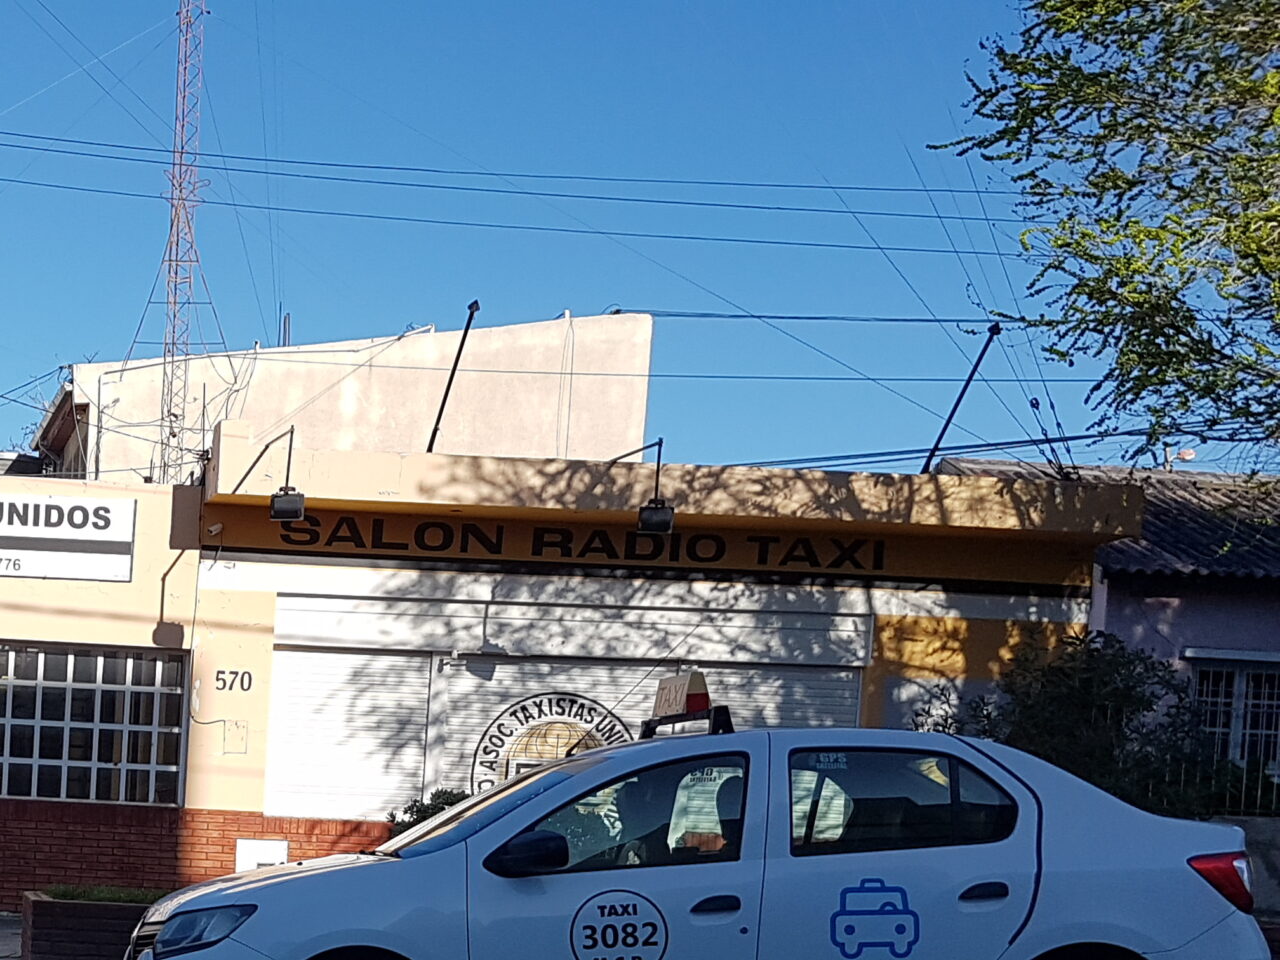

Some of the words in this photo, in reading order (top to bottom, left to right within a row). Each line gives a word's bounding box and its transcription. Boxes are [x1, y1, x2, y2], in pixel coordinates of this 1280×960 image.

[279, 514, 505, 555] SALON
[531, 527, 726, 563] RADIO
[746, 535, 886, 571] TAXI
[215, 669, 253, 692] 570
[659, 683, 687, 709] TAXI
[509, 697, 598, 726] TAXISTAS
[596, 903, 638, 918] TAXI
[582, 921, 658, 950] 3082
